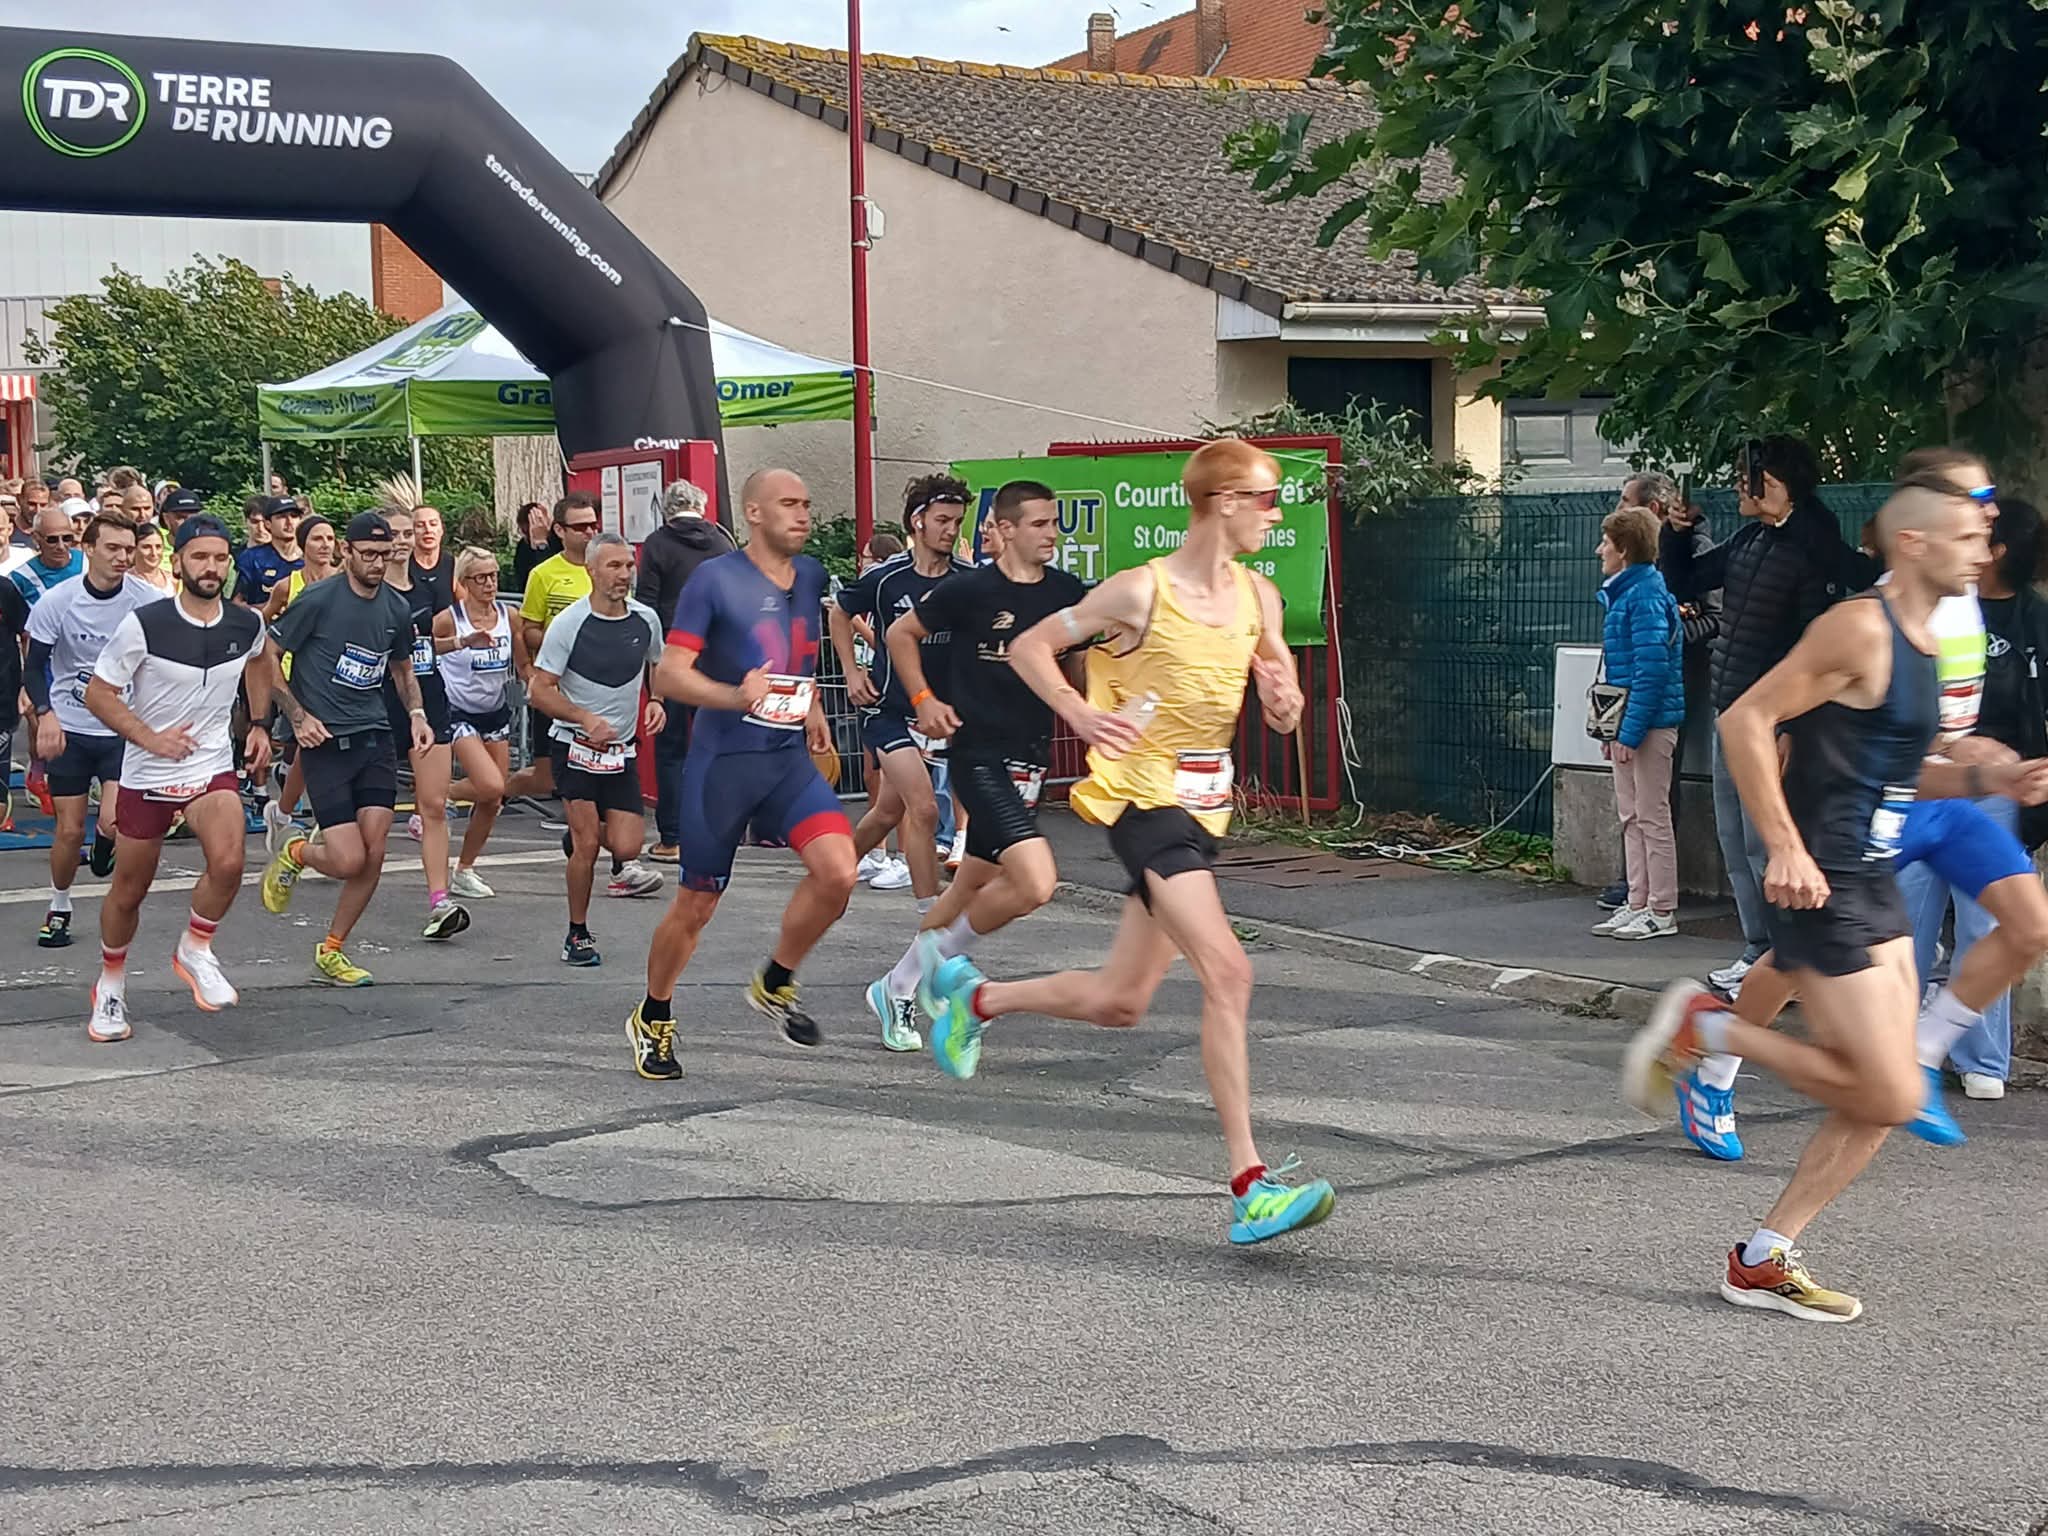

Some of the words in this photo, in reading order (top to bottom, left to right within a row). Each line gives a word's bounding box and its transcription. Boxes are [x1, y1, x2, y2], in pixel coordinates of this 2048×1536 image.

[43, 78, 131, 122] TDR
[153, 72, 271, 108] TERRE
[172, 107, 210, 132] DE
[211, 109, 393, 150] RUNNING
[485, 153, 623, 286] terrederunning.com
[498, 384, 551, 405] Gra
[717, 380, 794, 401] Omer
[1115, 480, 1192, 508] Courti
[1134, 526, 1150, 549] St
[1154, 525, 1188, 549] Ome
